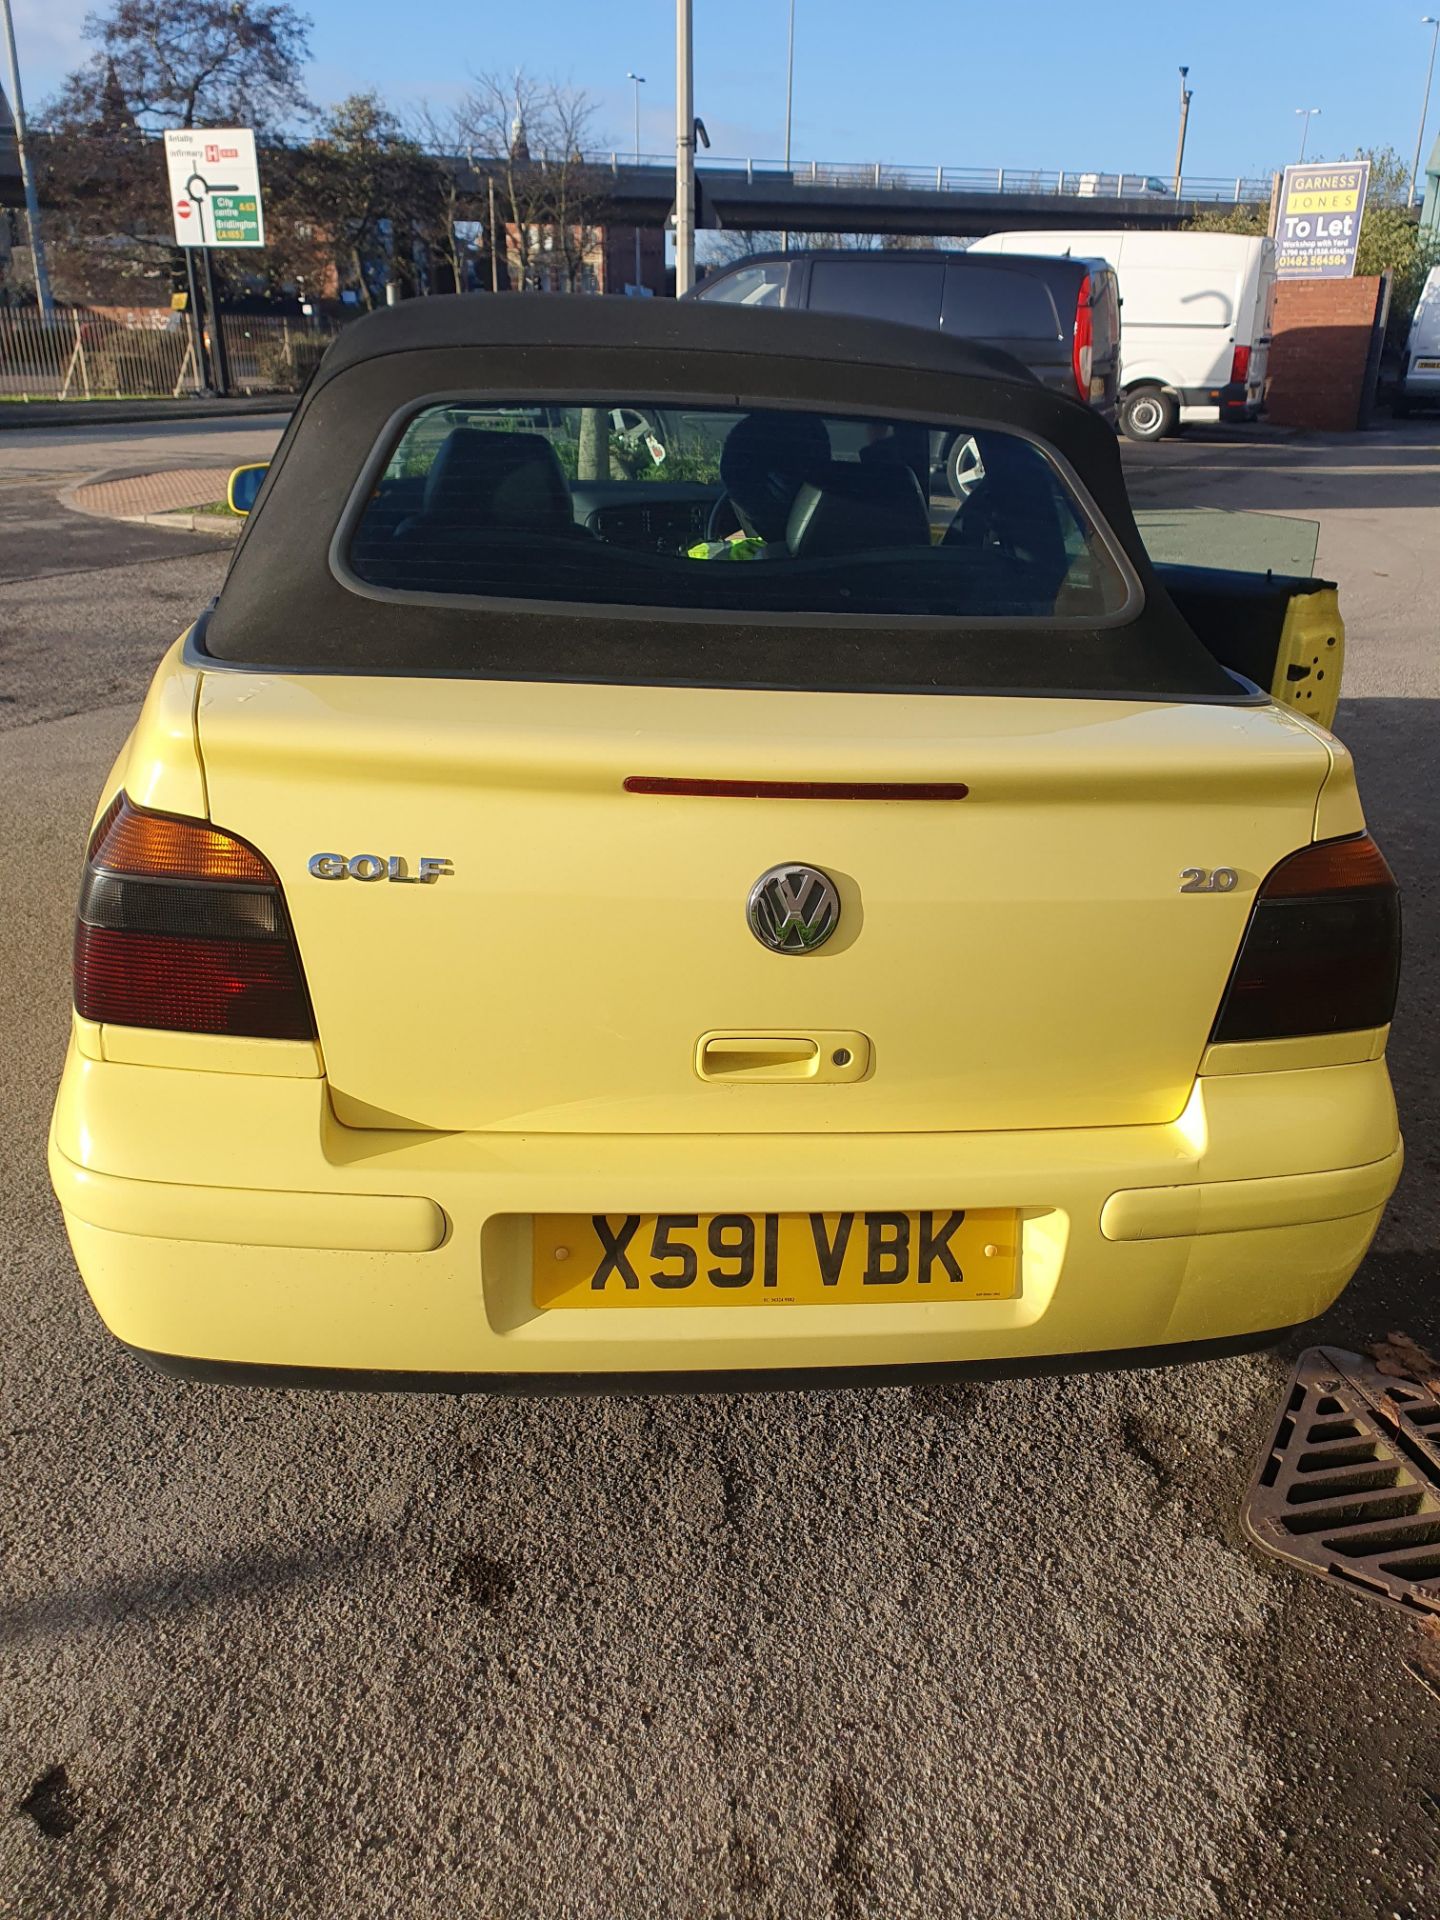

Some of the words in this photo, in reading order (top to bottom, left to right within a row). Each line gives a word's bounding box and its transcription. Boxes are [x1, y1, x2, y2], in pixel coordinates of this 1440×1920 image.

[206, 145, 219, 161] H
[1295, 175, 1356, 190] GARNESS
[216, 197, 234, 208] City
[1292, 194, 1352, 209] JONES
[214, 209, 239, 217] centre
[215, 219, 258, 229] Bridlington
[1284, 217, 1311, 238] To
[1316, 215, 1352, 237] Let
[1282, 240, 1316, 249] Workshop
[1316, 239, 1332, 248] with
[1333, 238, 1349, 247] Yard
[1279, 255, 1308, 267] 01482
[307, 853, 454, 885] GOLF
[591, 1212, 779, 1291] X591
[808, 1209, 967, 1287] VBK
